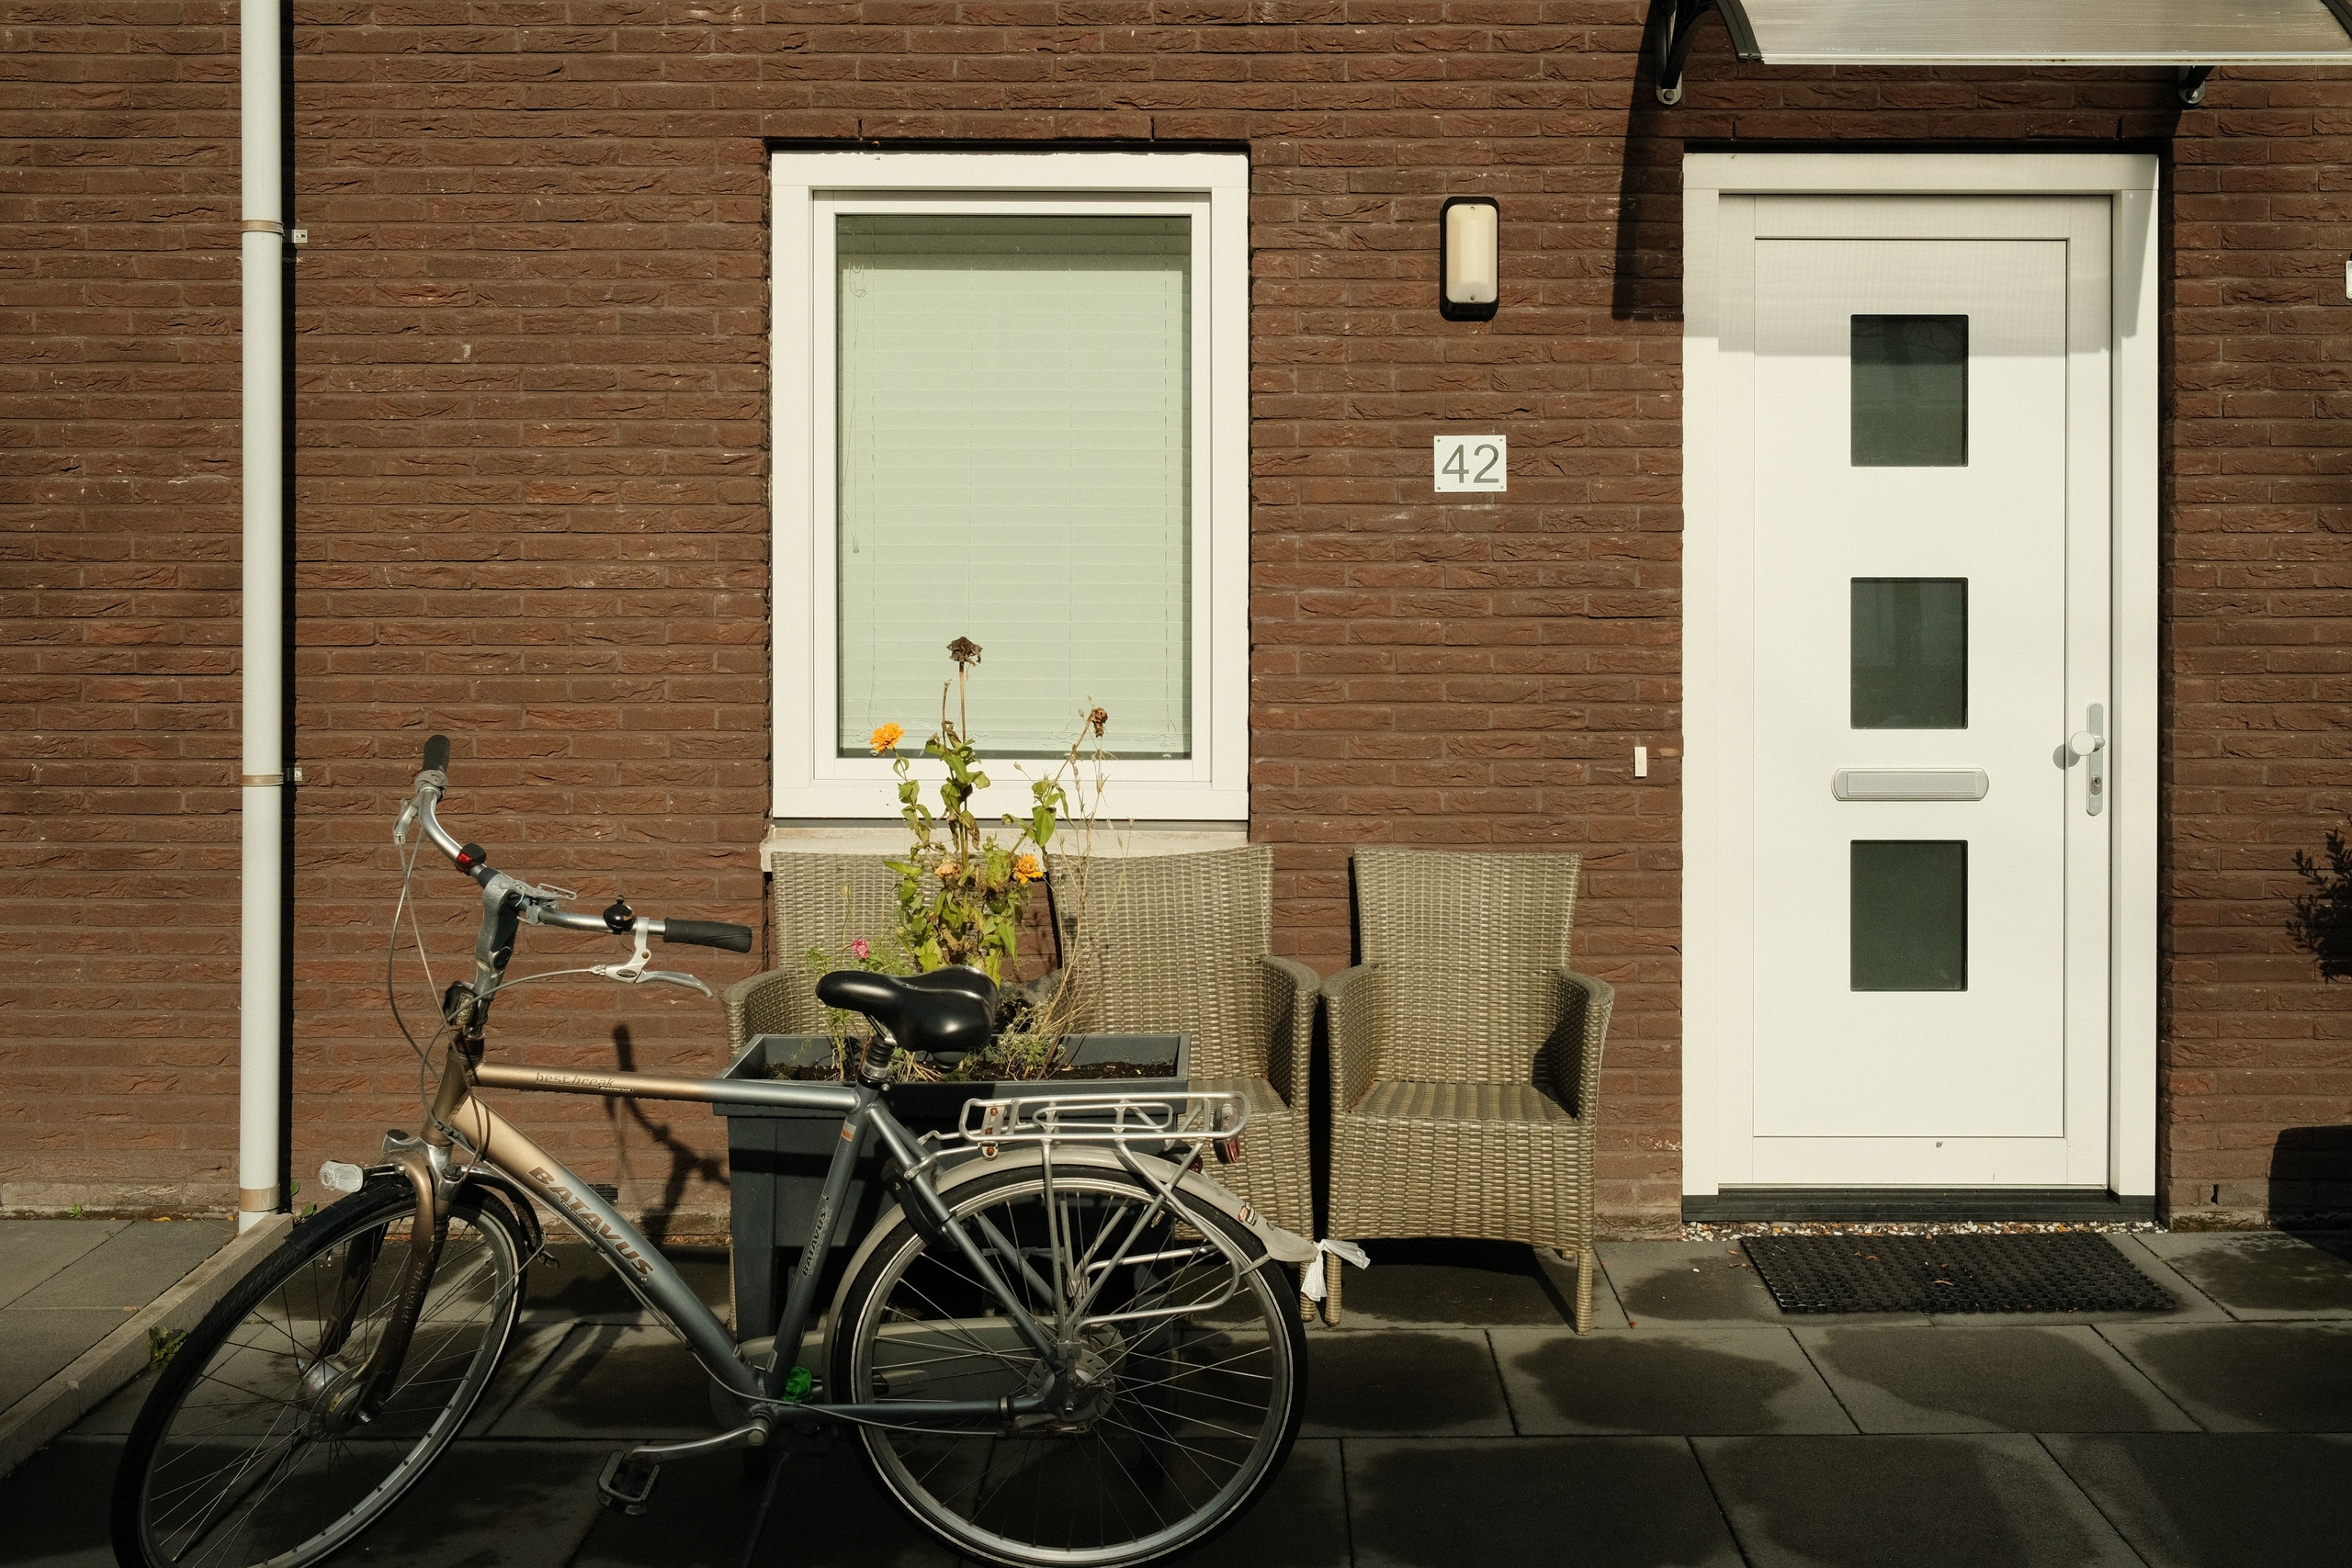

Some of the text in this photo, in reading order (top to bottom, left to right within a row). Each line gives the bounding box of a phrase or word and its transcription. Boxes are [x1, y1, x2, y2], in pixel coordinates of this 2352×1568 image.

[1442, 444, 1499, 483] 42
[536, 1072, 616, 1087] best break
[526, 1166, 654, 1276] BATAVUS
[802, 1207, 827, 1278] BATAVUS
